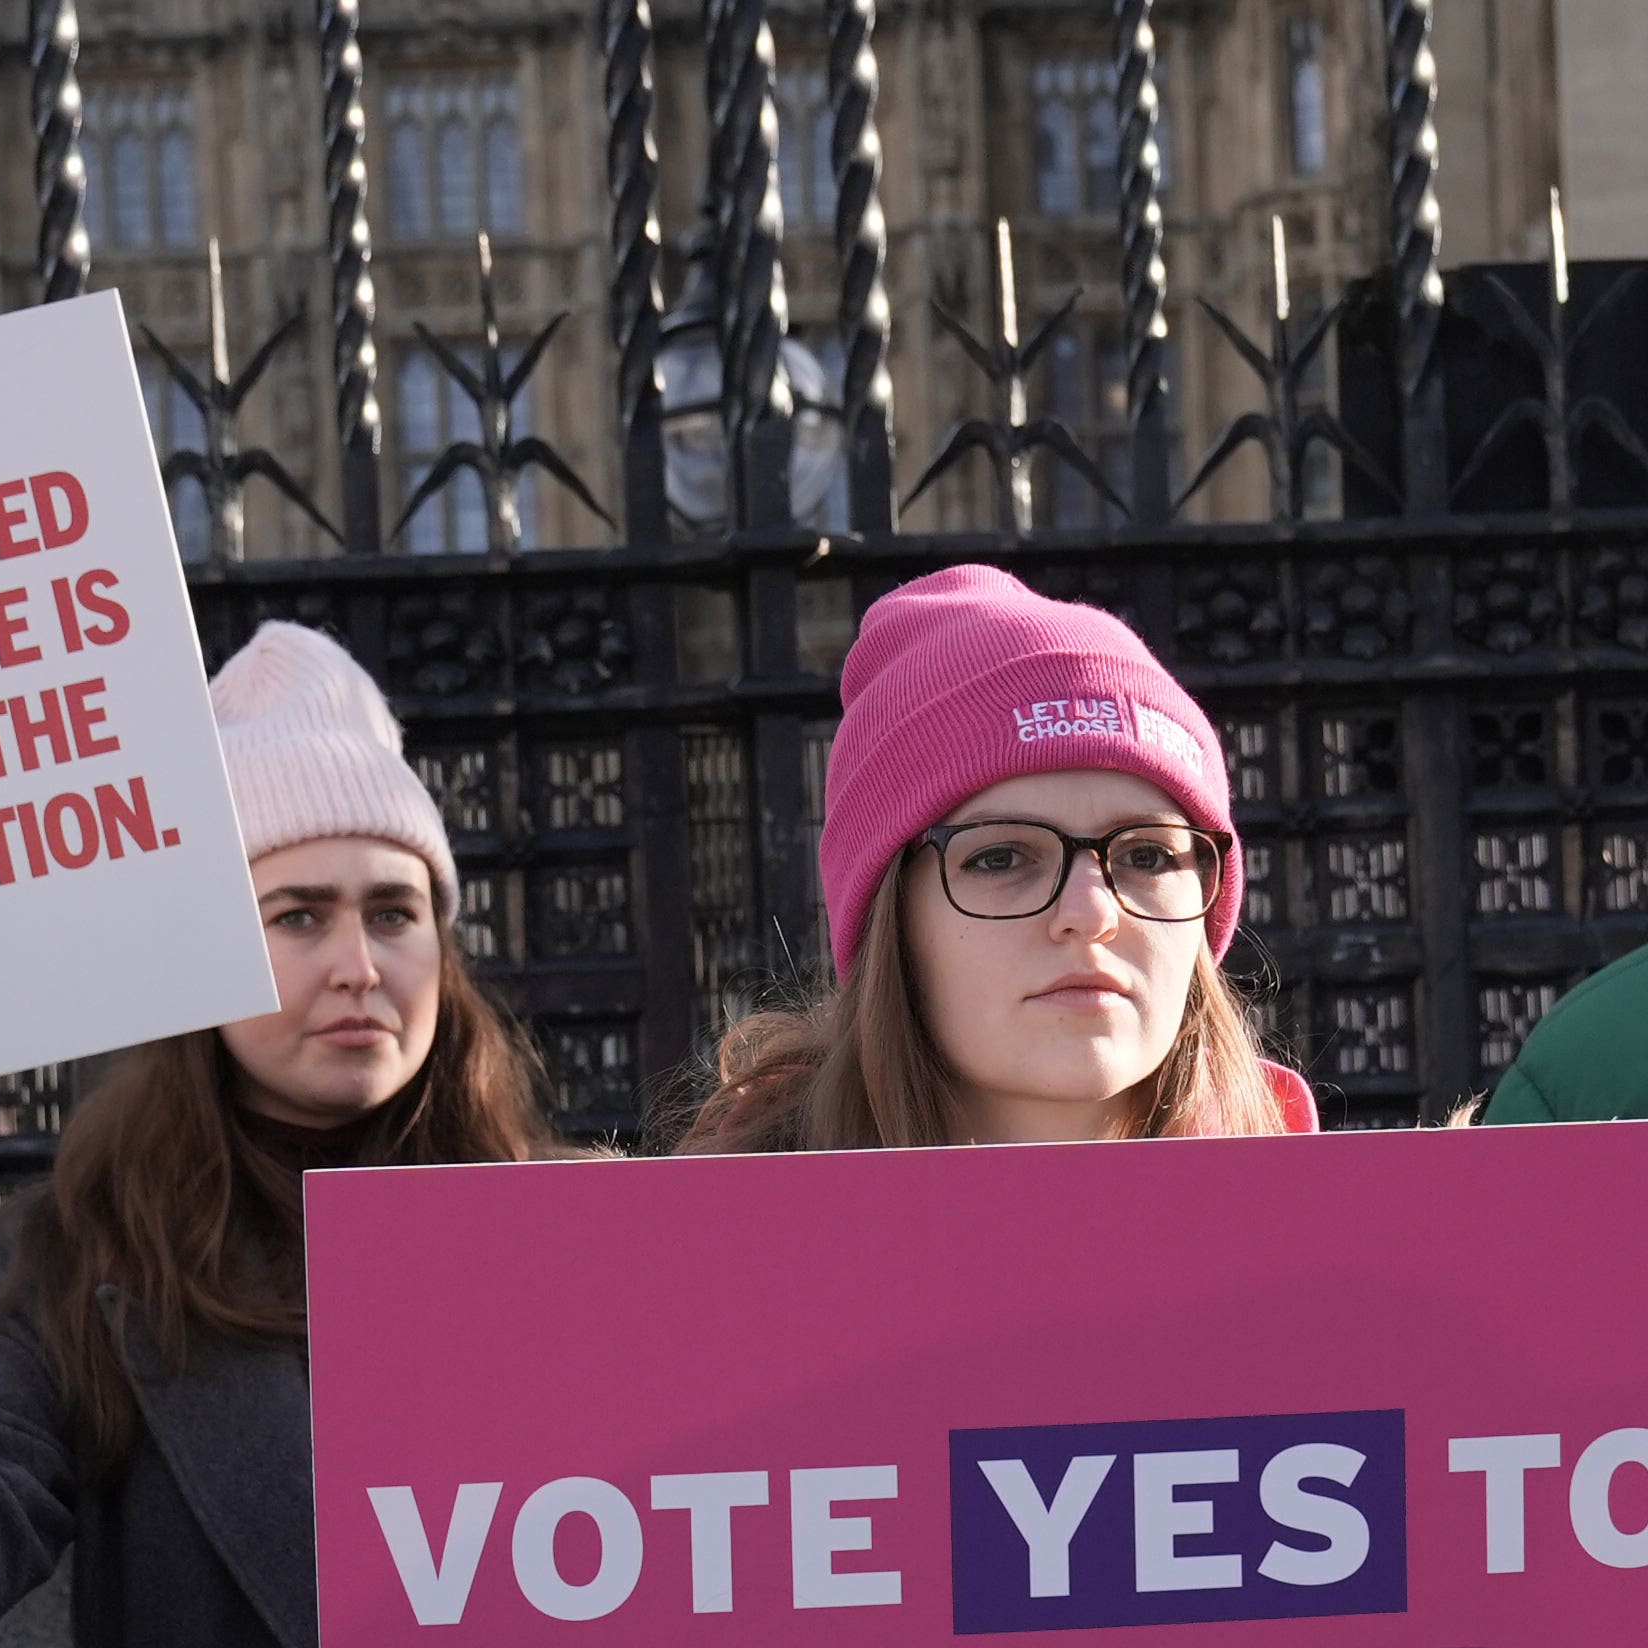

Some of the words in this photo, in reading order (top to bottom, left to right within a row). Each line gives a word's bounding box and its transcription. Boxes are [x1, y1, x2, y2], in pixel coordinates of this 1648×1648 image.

[52, 570, 130, 652] IS
[1013, 700, 1069, 726] LET
[1080, 698, 1118, 719] US
[1019, 719, 1123, 742] CHOOSE
[367, 1465, 901, 1625] VOTE
[978, 1444, 1369, 1597] YES
